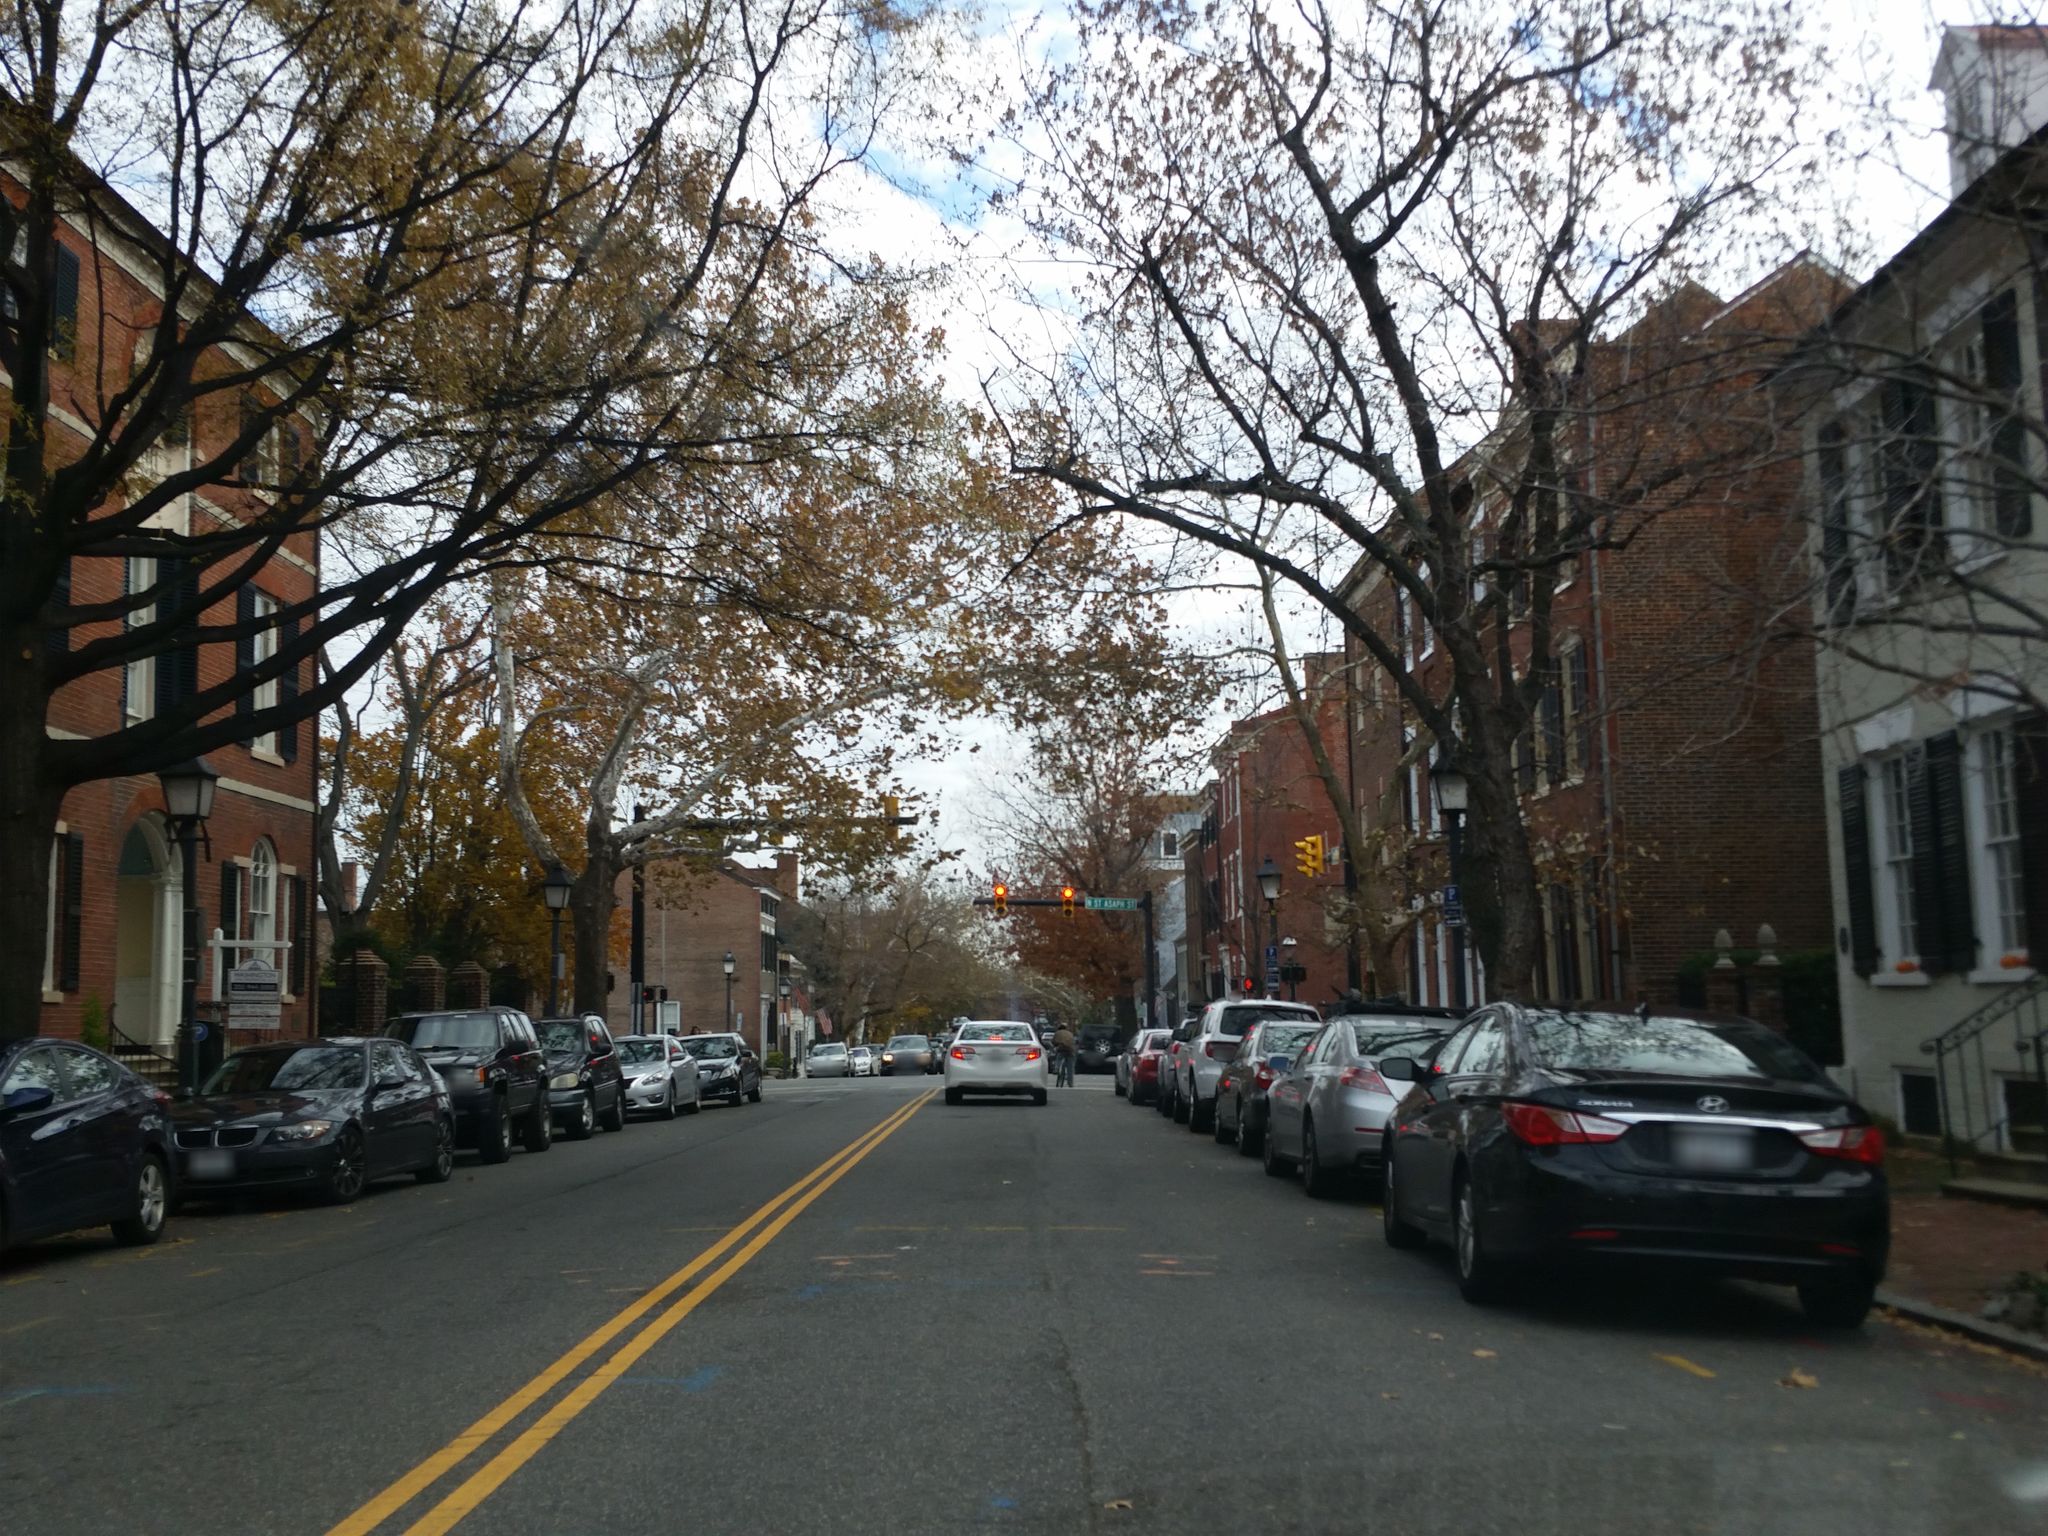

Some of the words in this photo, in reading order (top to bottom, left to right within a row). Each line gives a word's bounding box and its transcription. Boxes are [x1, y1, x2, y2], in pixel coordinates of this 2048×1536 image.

[1087, 899, 1092, 907] N
[1094, 899, 1101, 908] ST
[1104, 899, 1125, 908] ASAPH
[1127, 900, 1134, 909] ST
[1576, 1099, 1634, 1108] SONATA
